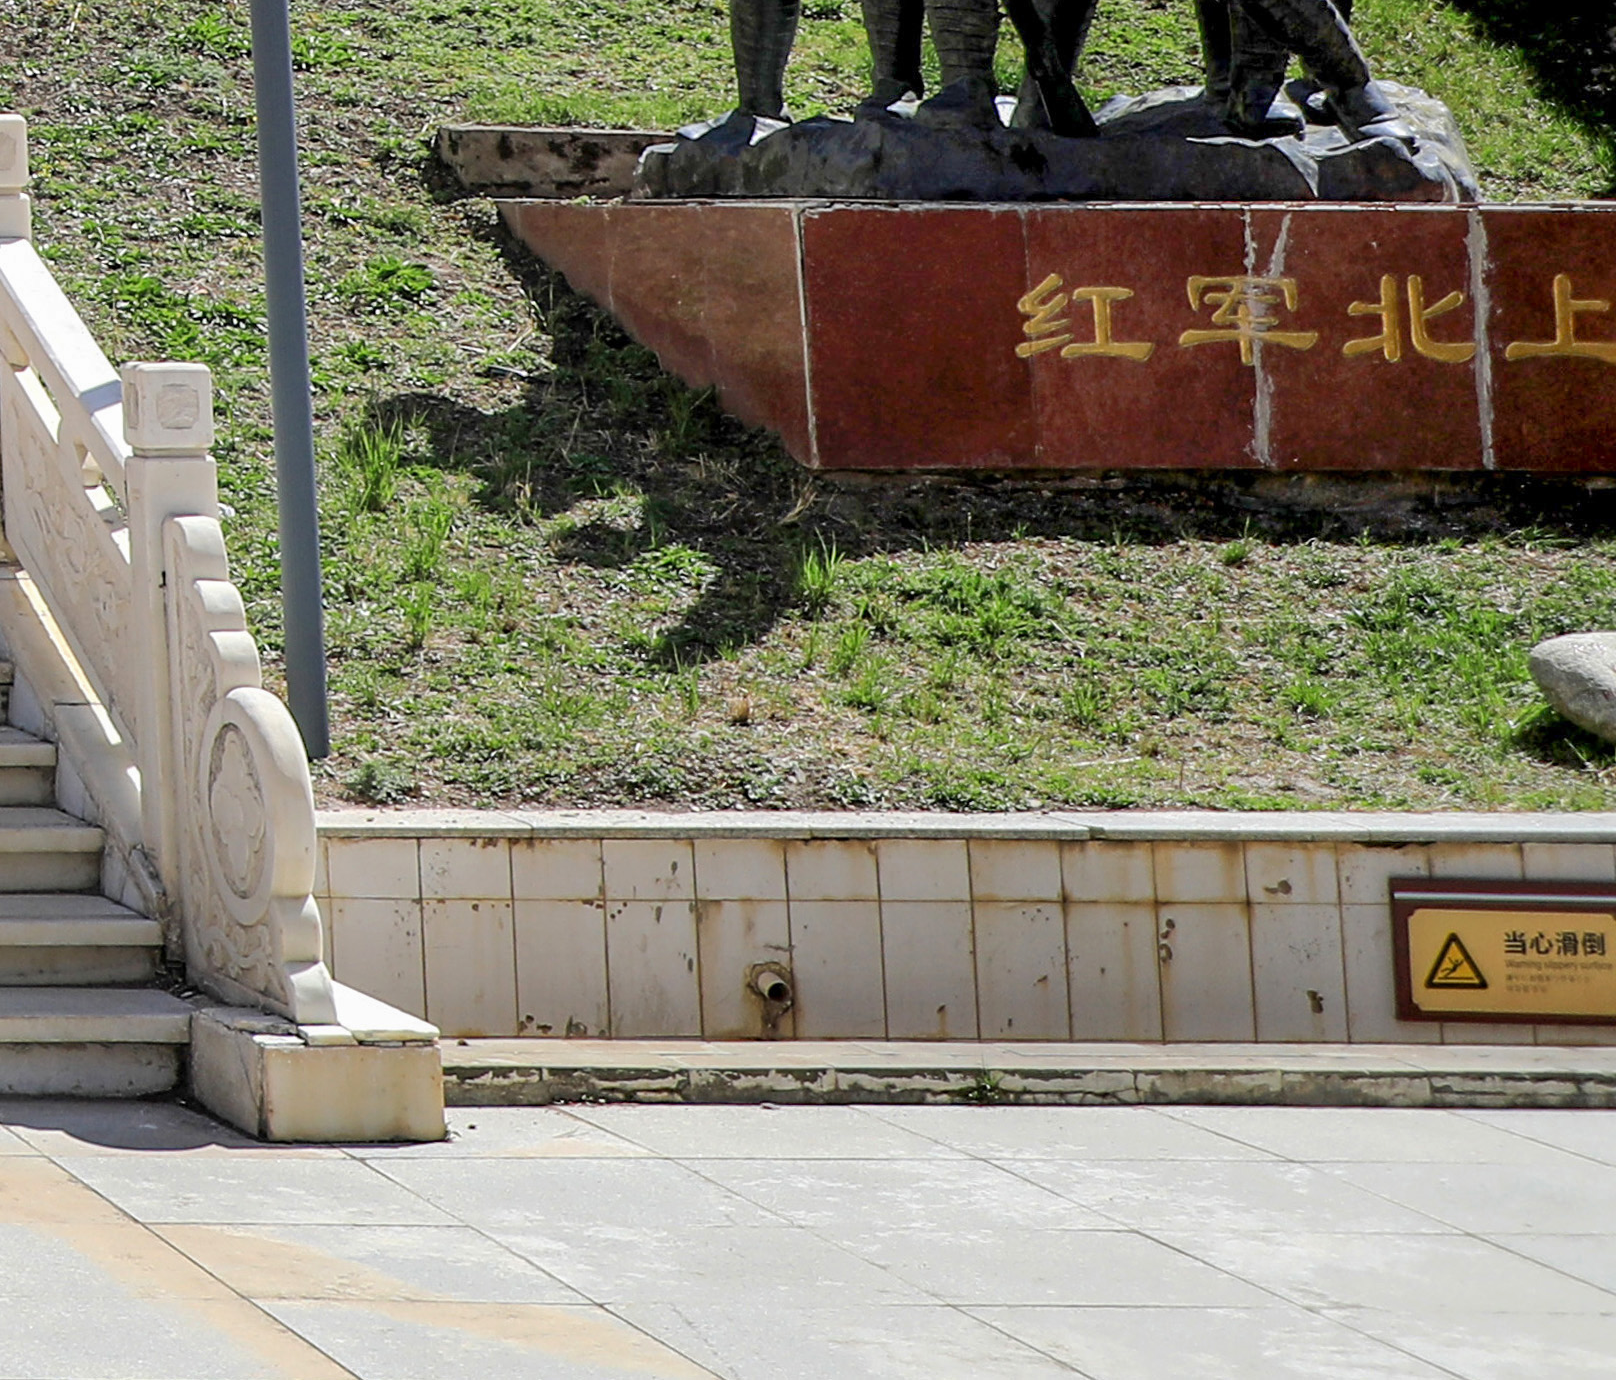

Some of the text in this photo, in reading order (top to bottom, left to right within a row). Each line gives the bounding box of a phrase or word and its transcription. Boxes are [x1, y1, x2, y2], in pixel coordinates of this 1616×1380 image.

[1014, 272, 1616, 366] 红军北上
[1504, 930, 1606, 957] 当心滑倒
